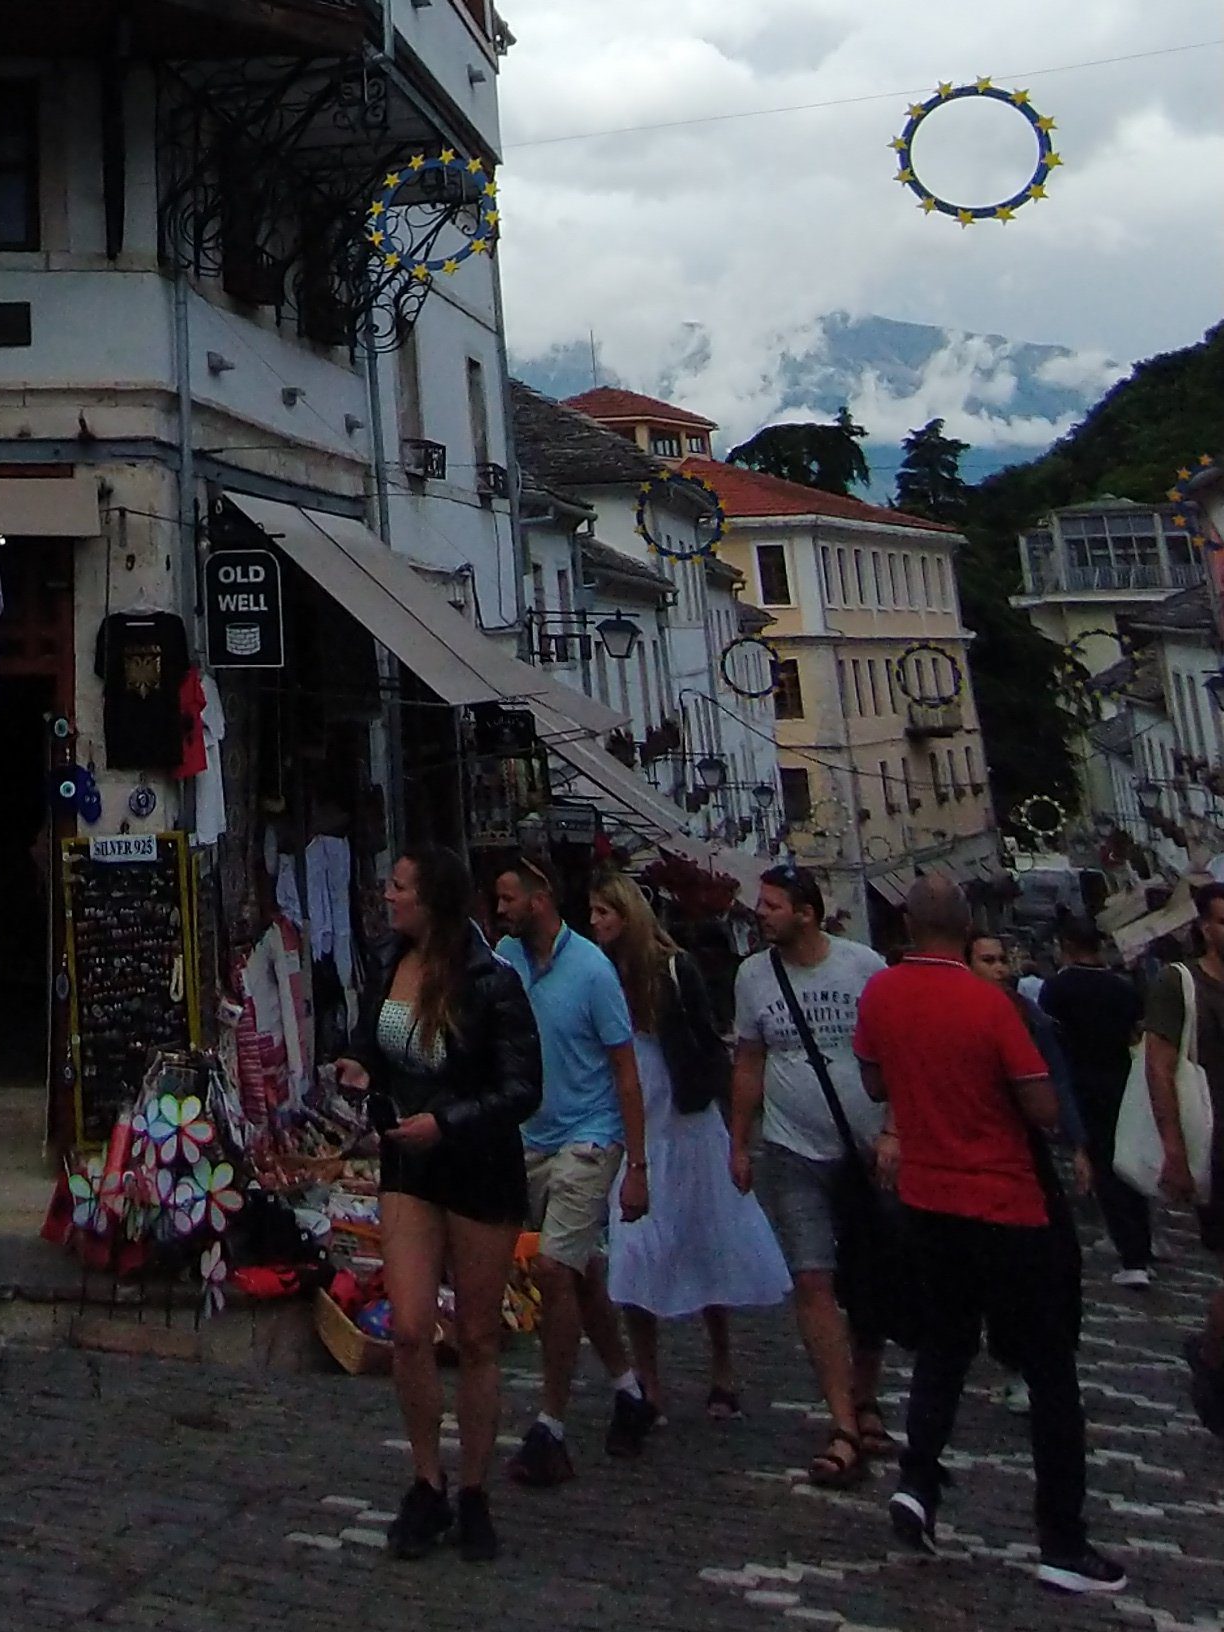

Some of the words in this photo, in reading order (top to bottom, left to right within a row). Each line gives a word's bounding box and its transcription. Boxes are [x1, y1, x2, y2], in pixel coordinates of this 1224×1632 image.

[218, 565, 265, 584] OLD
[218, 593, 268, 612] WELL
[94, 840, 133, 856] SILVER
[133, 839, 153, 855] 925
